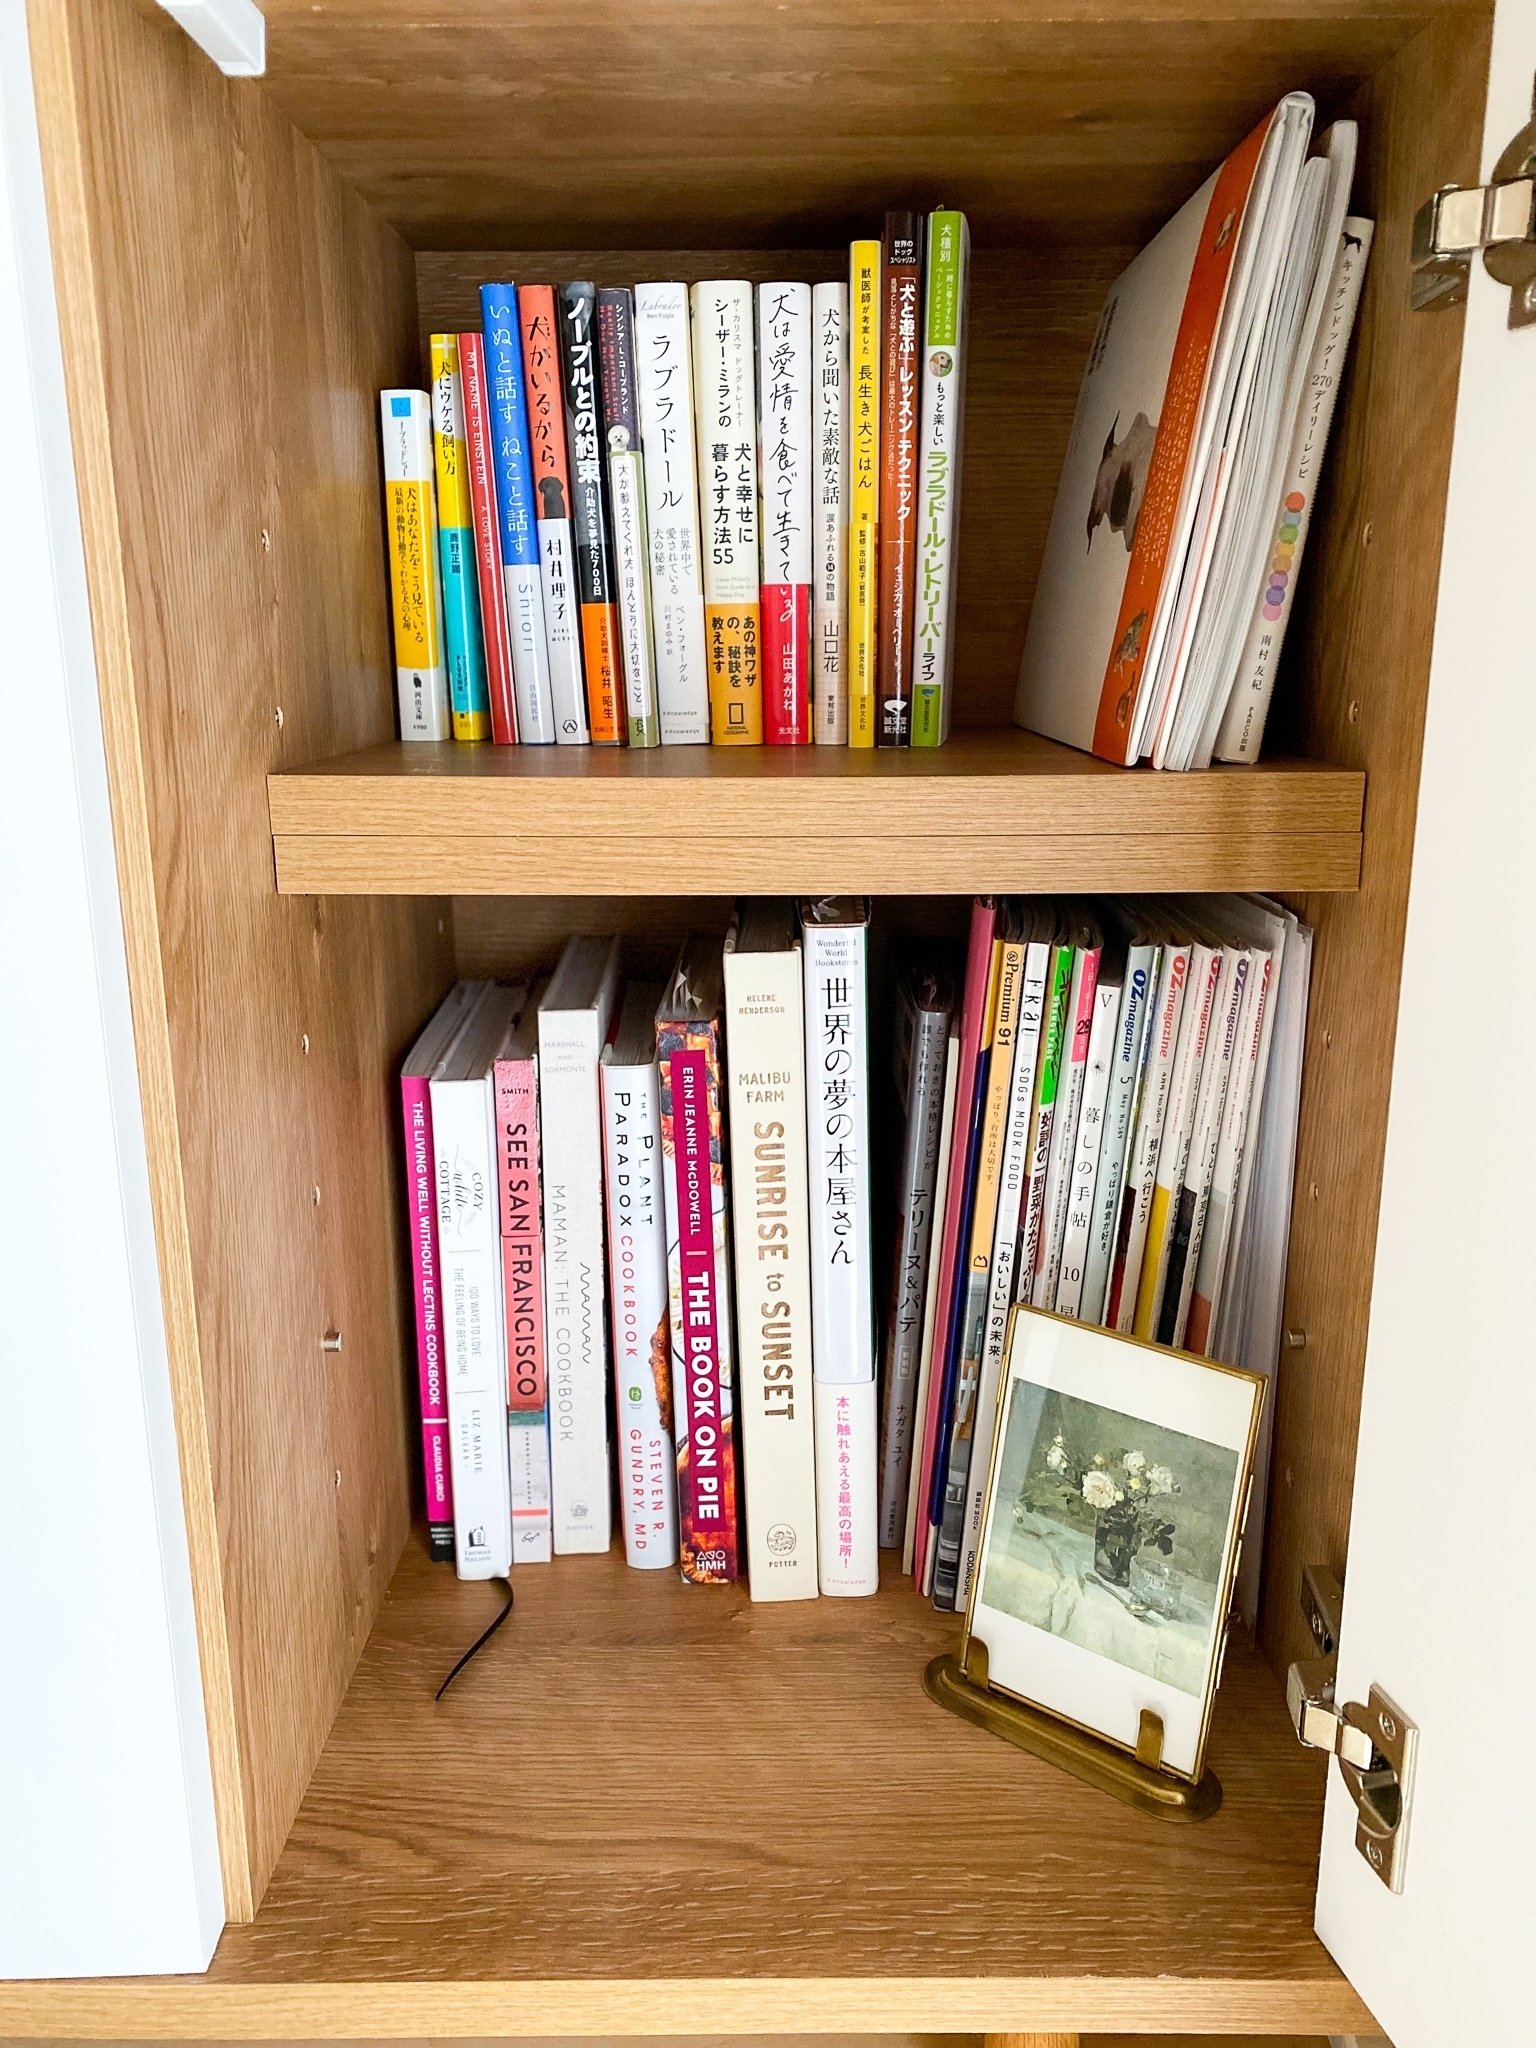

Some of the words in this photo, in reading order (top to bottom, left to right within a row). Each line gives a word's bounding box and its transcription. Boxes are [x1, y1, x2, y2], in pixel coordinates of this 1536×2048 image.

[889, 258, 917, 267] スペシャリスト
[894, 240, 914, 248] 世界の
[894, 249, 913, 258] ドッグ
[939, 223, 954, 264] 犬種別
[641, 295, 683, 312] Labrador
[732, 298, 743, 350] ザ・カリスマ
[861, 267, 873, 355] 獣医師が考案した
[490, 304, 518, 424] いぬと話す
[715, 298, 732, 428] シーザー・ミランの
[468, 375, 481, 410] NAME
[526, 316, 556, 469] 犬がいるから
[567, 297, 601, 484] ノーブルとの約束
[734, 359, 745, 427] ドッグトレーナー
[820, 307, 841, 505] 犬から聞いた素敵な話
[933, 382, 947, 446] もっと楽しい
[439, 361, 456, 476] 犬にウケる飼い方
[472, 416, 482, 427] IS
[651, 335, 684, 511] ラブラドール
[857, 364, 873, 489] 長生き犬ごはん
[473, 429, 488, 485] EINSTEIN
[501, 436, 529, 555] ねこと話す
[712, 444, 732, 545] 暮らす方法
[734, 443, 754, 544] 犬と幸せに
[481, 514, 490, 536] LOVE
[406, 487, 425, 643] 犬はあなたをこう見ている
[484, 541, 493, 570] STORY
[679, 528, 692, 576] 世界中で
[547, 538, 568, 621] 村井理子
[676, 606, 688, 683] ベン・フォーグル
[712, 619, 726, 674] 教えます
[727, 619, 743, 688] の、秘訣を
[743, 616, 757, 687] あの神ワザ
[823, 620, 840, 673] 山口花
[1251, 633, 1272, 691] 南村友紀
[600, 665, 612, 689] 桜井
[602, 695, 615, 719] 昭生
[778, 726, 801, 735] 光文社
[825, 949, 848, 957] World
[738, 1006, 785, 1015] HENDERSON
[746, 994, 777, 1003] HELENE
[1101, 993, 1114, 1008] V
[1122, 969, 1147, 1063] OZmagazine
[1159, 954, 1186, 1059] OZmagazine
[1195, 956, 1222, 1059] OZmagazine
[1222, 959, 1248, 1061] OZmagazine
[997, 1028, 1012, 1048] 91
[682, 1066, 695, 1099] ERIN
[738, 1072, 792, 1086] MALIBU
[746, 1091, 785, 1103] FARM
[1017, 1066, 1031, 1102] SDGs
[1120, 1076, 1134, 1086] 5
[413, 1101, 426, 1127] THE
[639, 1092, 647, 1119] THE
[683, 1102, 698, 1156] JEANNE
[821, 977, 858, 1265] 世界の夢の本屋さん
[1012, 1110, 1026, 1147] MOOK
[414, 1131, 428, 1175] LIVING
[507, 1124, 530, 1170] SEE
[614, 1092, 632, 1227] PARADOX
[1007, 1155, 1021, 1191] FOOD
[1069, 1107, 1101, 1228] 暮しの手帖
[416, 1178, 430, 1213] WELL
[439, 1160, 453, 1223] COTTAGE
[472, 1172, 485, 1211] COZY
[508, 1180, 531, 1232] SAN
[637, 1135, 653, 1225] PLANT
[754, 1121, 790, 1262] SUNRISE
[419, 1216, 434, 1276] WITHOUT
[552, 1185, 569, 1273] MAMAN:
[554, 1279, 570, 1316] THE
[620, 1235, 638, 1356] COOKBOOK
[687, 1271, 711, 1326] THE
[766, 1272, 785, 1293] to
[1062, 1266, 1080, 1282] 10
[423, 1280, 436, 1332] LECTINS
[511, 1244, 537, 1397] FRANCISCO
[426, 1336, 440, 1405] COOKBOOK
[556, 1328, 573, 1442] COOKBOOK
[690, 1336, 716, 1418] BOOK
[761, 1301, 795, 1421] SUNSET
[472, 1410, 481, 1428] LIZ
[895, 1404, 908, 1440] ナガタ
[432, 1436, 442, 1474] CLAUDIA
[472, 1437, 483, 1474] MARIE
[630, 1429, 645, 1514] GUNDRY,
[694, 1425, 718, 1467] ON
[892, 1445, 905, 1468] ユイ
[649, 1440, 665, 1511] STEVEN
[697, 1477, 720, 1519] PIE
[634, 1524, 647, 1550] MD
[652, 1522, 665, 1538] R.
[696, 1560, 726, 1570] HMH
[768, 1560, 798, 1568] POTTER
